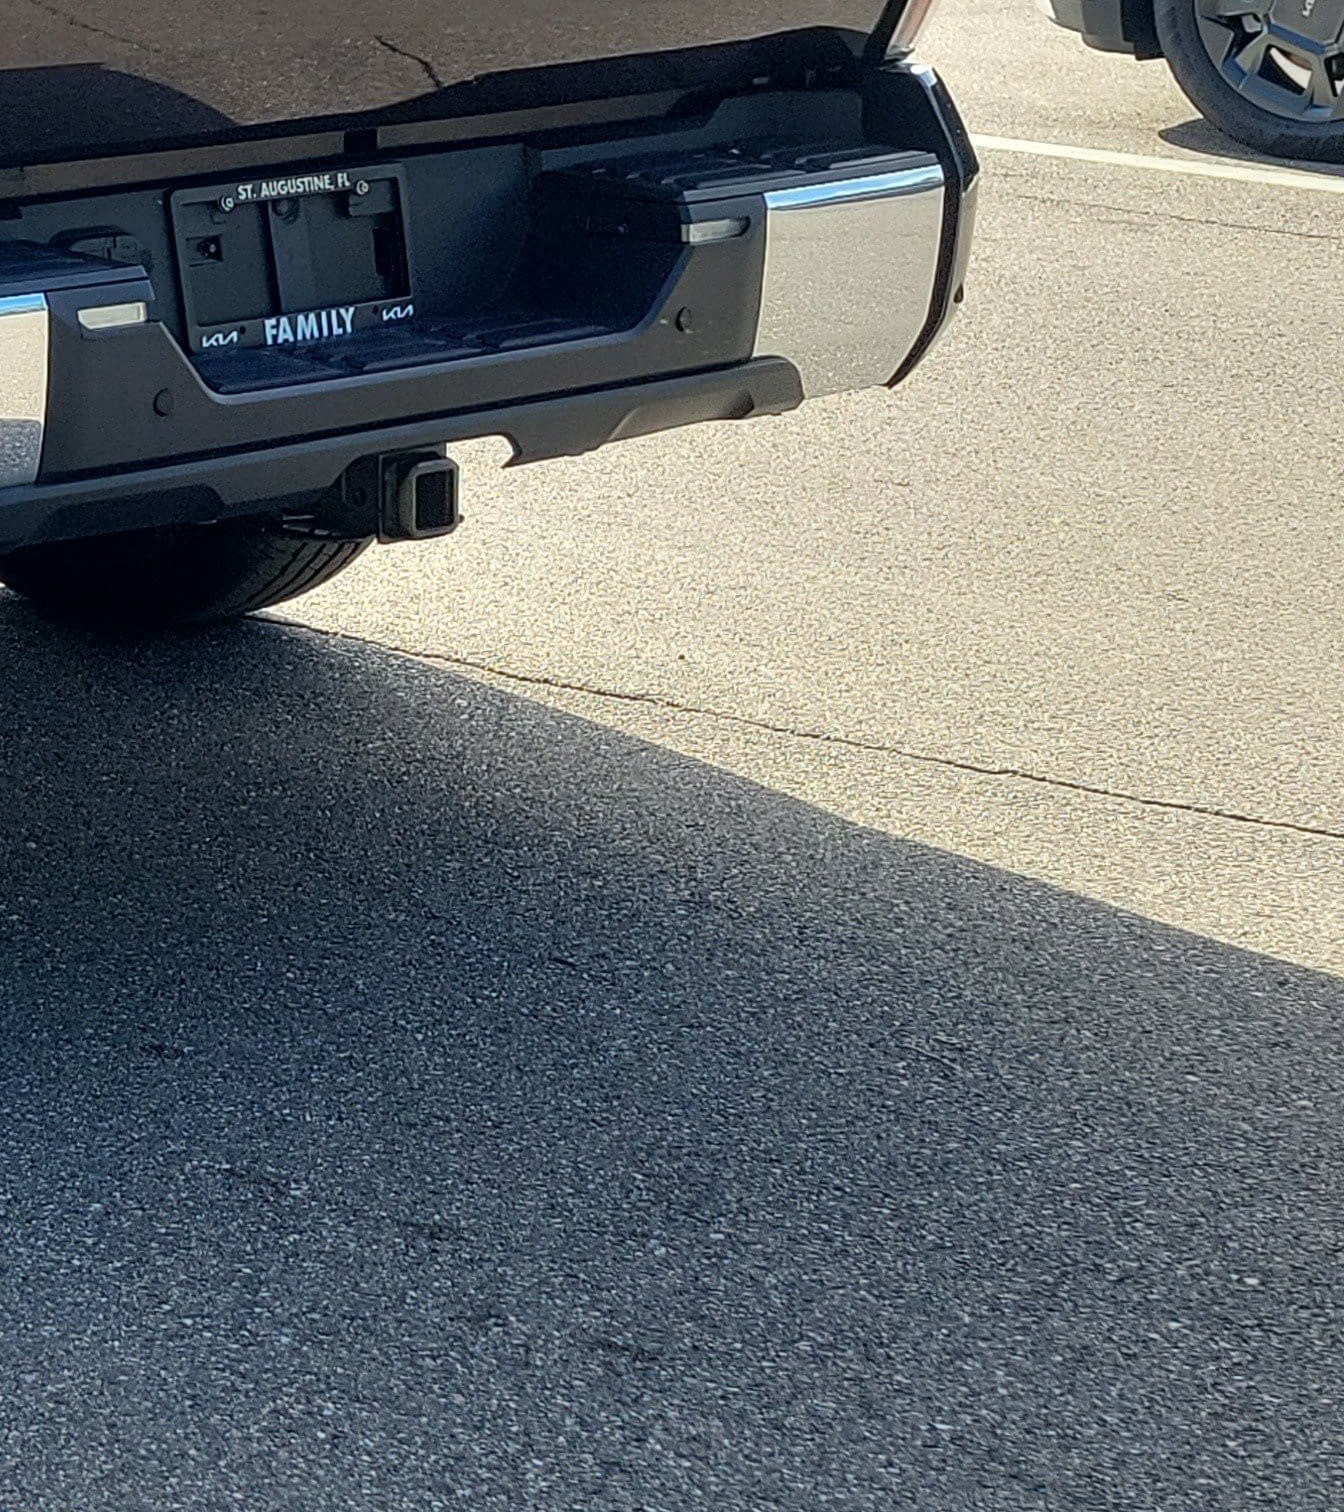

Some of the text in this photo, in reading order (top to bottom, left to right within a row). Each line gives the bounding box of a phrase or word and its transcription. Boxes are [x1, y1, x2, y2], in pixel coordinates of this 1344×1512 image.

[237, 184, 257, 200] ST.
[337, 172, 351, 187] FL
[264, 307, 355, 345] FAMILY
